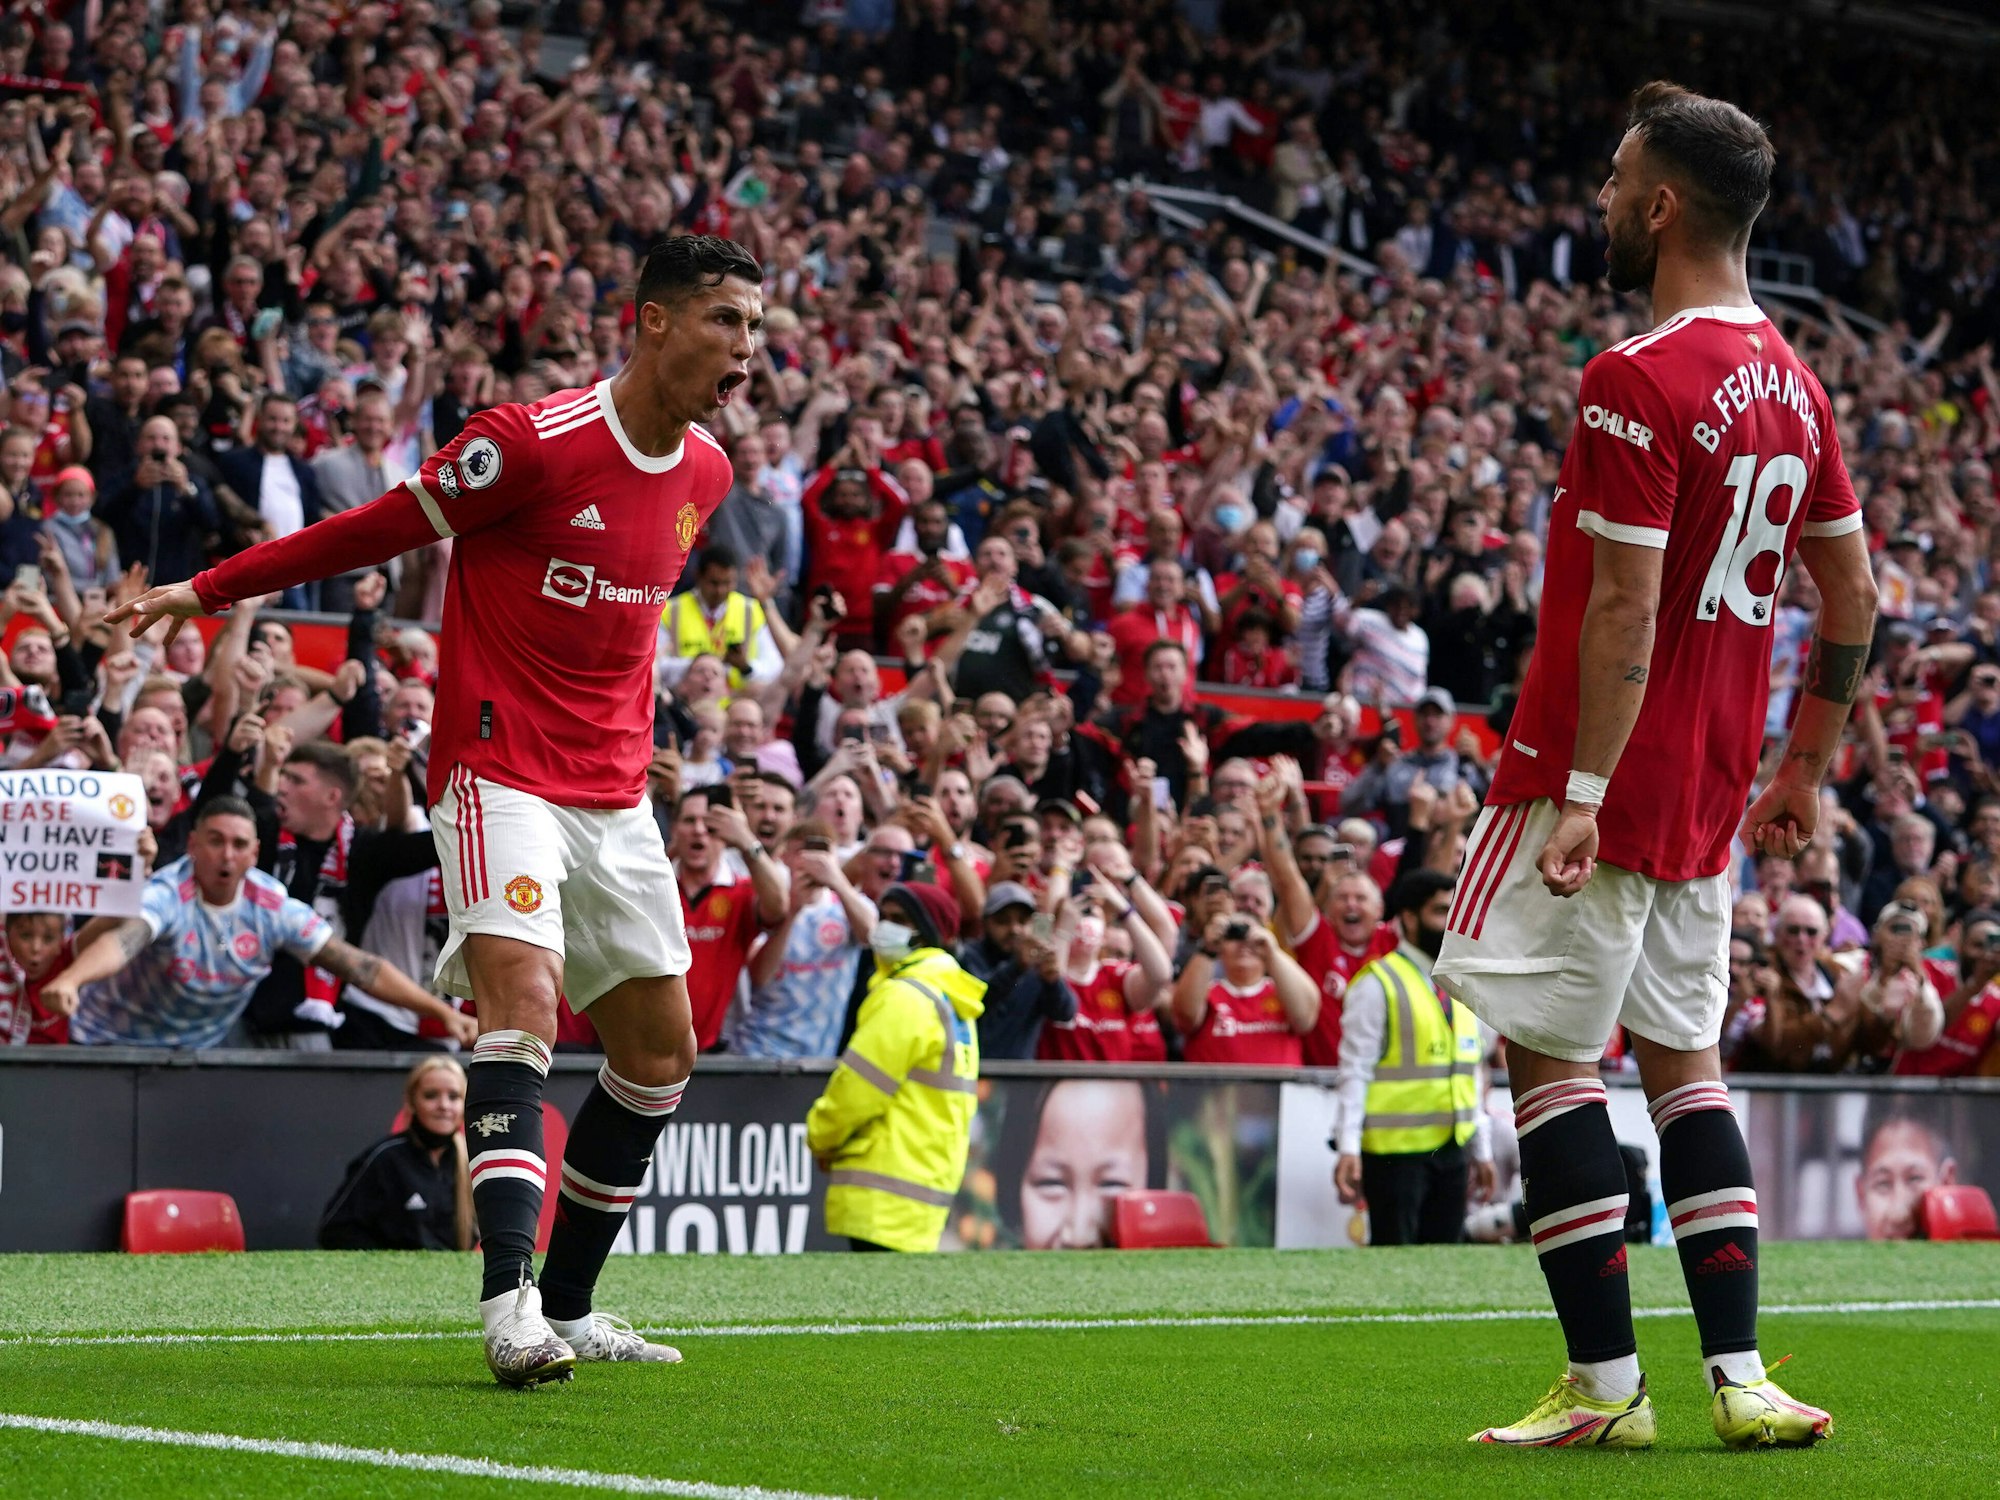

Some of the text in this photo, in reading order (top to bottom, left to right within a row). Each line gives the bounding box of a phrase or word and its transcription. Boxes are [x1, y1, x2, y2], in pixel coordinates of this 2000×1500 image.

[1583, 405, 1654, 452] OHLER
[570, 518, 606, 530] adidas
[1696, 454, 1809, 627] 18
[3, 801, 73, 822] EASE
[23, 825, 30, 844] I
[45, 825, 115, 847] HAVE
[4, 852, 79, 872] YOUR
[12, 881, 103, 908] SHIRT
[637, 1122, 812, 1198] WNLOAD
[608, 1201, 810, 1255] NOW
[1696, 1259, 1754, 1275] adidas
